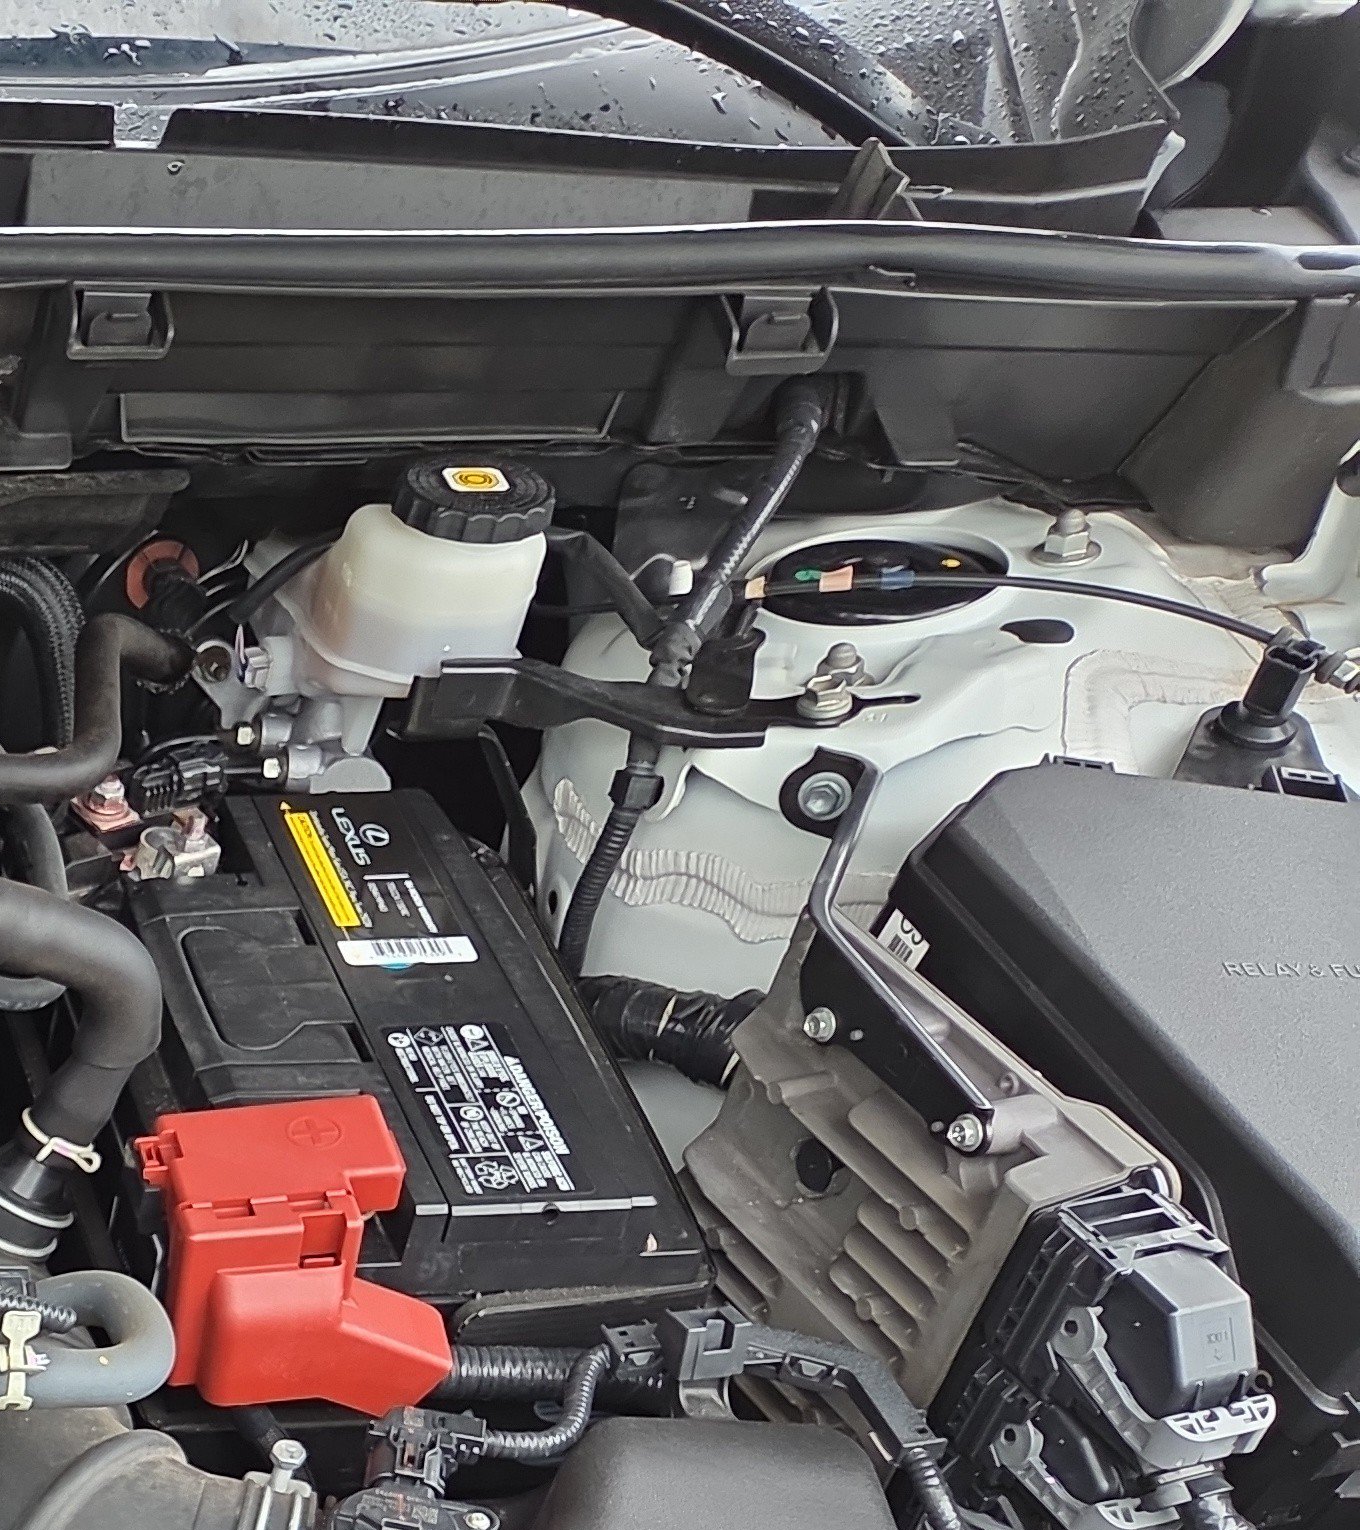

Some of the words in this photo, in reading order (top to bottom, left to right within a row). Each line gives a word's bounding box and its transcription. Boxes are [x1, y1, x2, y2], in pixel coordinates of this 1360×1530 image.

[331, 807, 372, 866] LEXUS
[1221, 961, 1302, 977] RELAY
[1308, 963, 1327, 978] &
